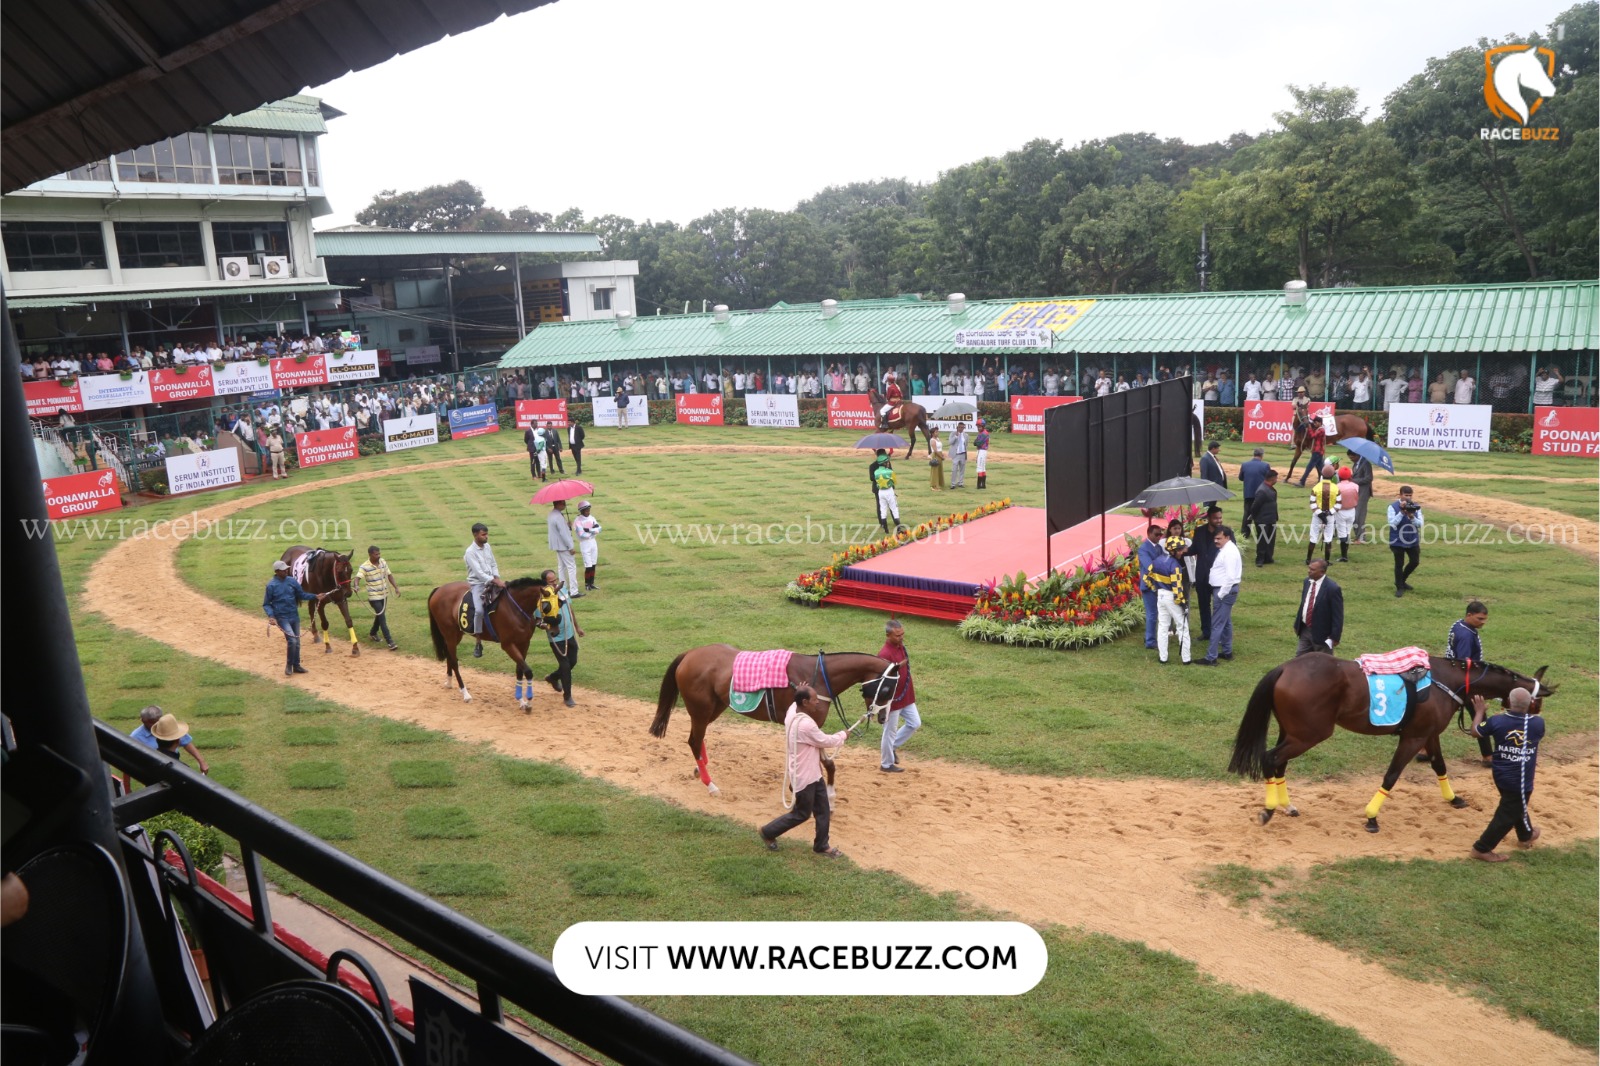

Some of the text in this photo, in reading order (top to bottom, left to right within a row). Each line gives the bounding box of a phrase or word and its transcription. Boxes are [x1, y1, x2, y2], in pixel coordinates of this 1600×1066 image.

[275, 368, 325, 379] POONAWALLA
[240, 375, 268, 384] INSTITUTE
[278, 375, 324, 387] STUD FARMS
[154, 380, 210, 392] POONAWALLA
[228, 385, 243, 393] INDIA
[169, 389, 198, 399] GROUP
[831, 410, 875, 418] POONAWALL
[834, 418, 852, 426] STUD
[1249, 420, 1293, 431] POONAW
[1013, 424, 1036, 432] BANGALORE
[1330, 424, 1335, 432] 2
[1396, 426, 1483, 438] SERUM INSTITUTE
[1268, 432, 1291, 442] GRO
[1540, 430, 1598, 441] POONAW
[302, 442, 355, 456] POONAWALLA
[1394, 438, 1484, 450] OF INDIA PVT. LTD.
[1542, 442, 1582, 453] STUD
[305, 450, 354, 464] STUD FARMS
[174, 466, 236, 482] SERUM INSTITUTE
[174, 474, 238, 492] OF INDIA PVT. LTD.
[46, 487, 115, 506] OONAWALLA
[61, 500, 99, 514] GROUP
[460, 612, 468, 628] 6
[1374, 692, 1386, 716] 3
